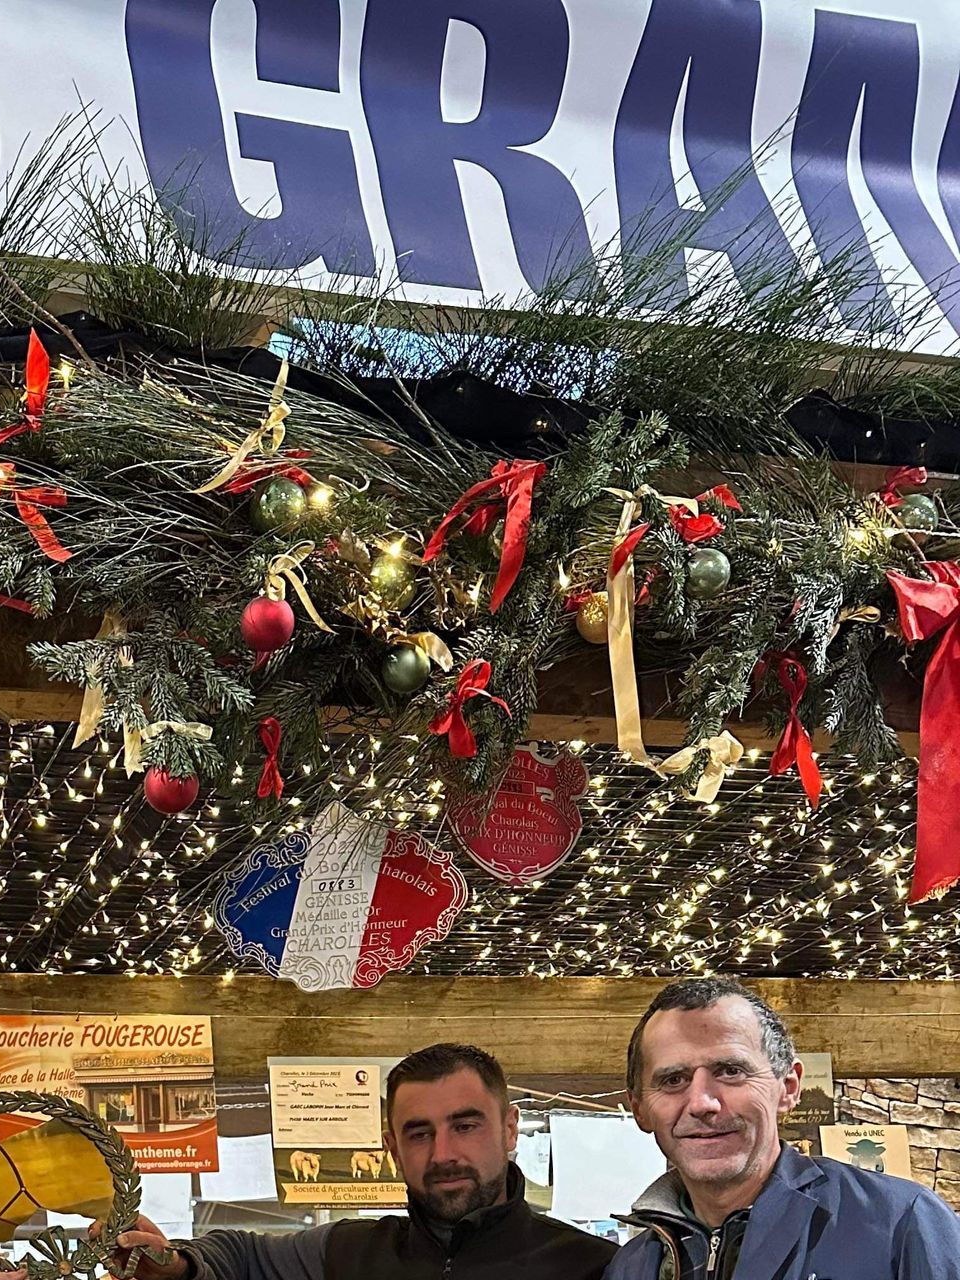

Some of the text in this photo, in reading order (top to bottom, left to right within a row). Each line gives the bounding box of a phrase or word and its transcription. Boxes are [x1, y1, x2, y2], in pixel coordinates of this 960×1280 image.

[491, 813, 539, 829] Charolais
[495, 828, 566, 846] D'HONNEUR
[493, 841, 537, 856] GÉNISSE
[240, 860, 438, 913] Festival du Boeuf Charolais
[305, 892, 369, 909] GÉNISSE
[295, 906, 382, 924] Médaille d'Or
[270, 919, 407, 939] Grand Prix d'Honneur
[286, 932, 391, 954] CHAROLLES
[80, 1024, 205, 1047] FOUGEROUSE
[21, 1070, 34, 1083] de
[37, 1068, 45, 1082] la
[50, 1068, 75, 1081] Halle
[844, 1129, 862, 1137] Vendu
[869, 1129, 885, 1137] UNEC
[293, 1184, 320, 1193] Société
[321, 1184, 370, 1195] d'Agriculture
[371, 1185, 378, 1193] et
[343, 1193, 378, 1201] Charolais
